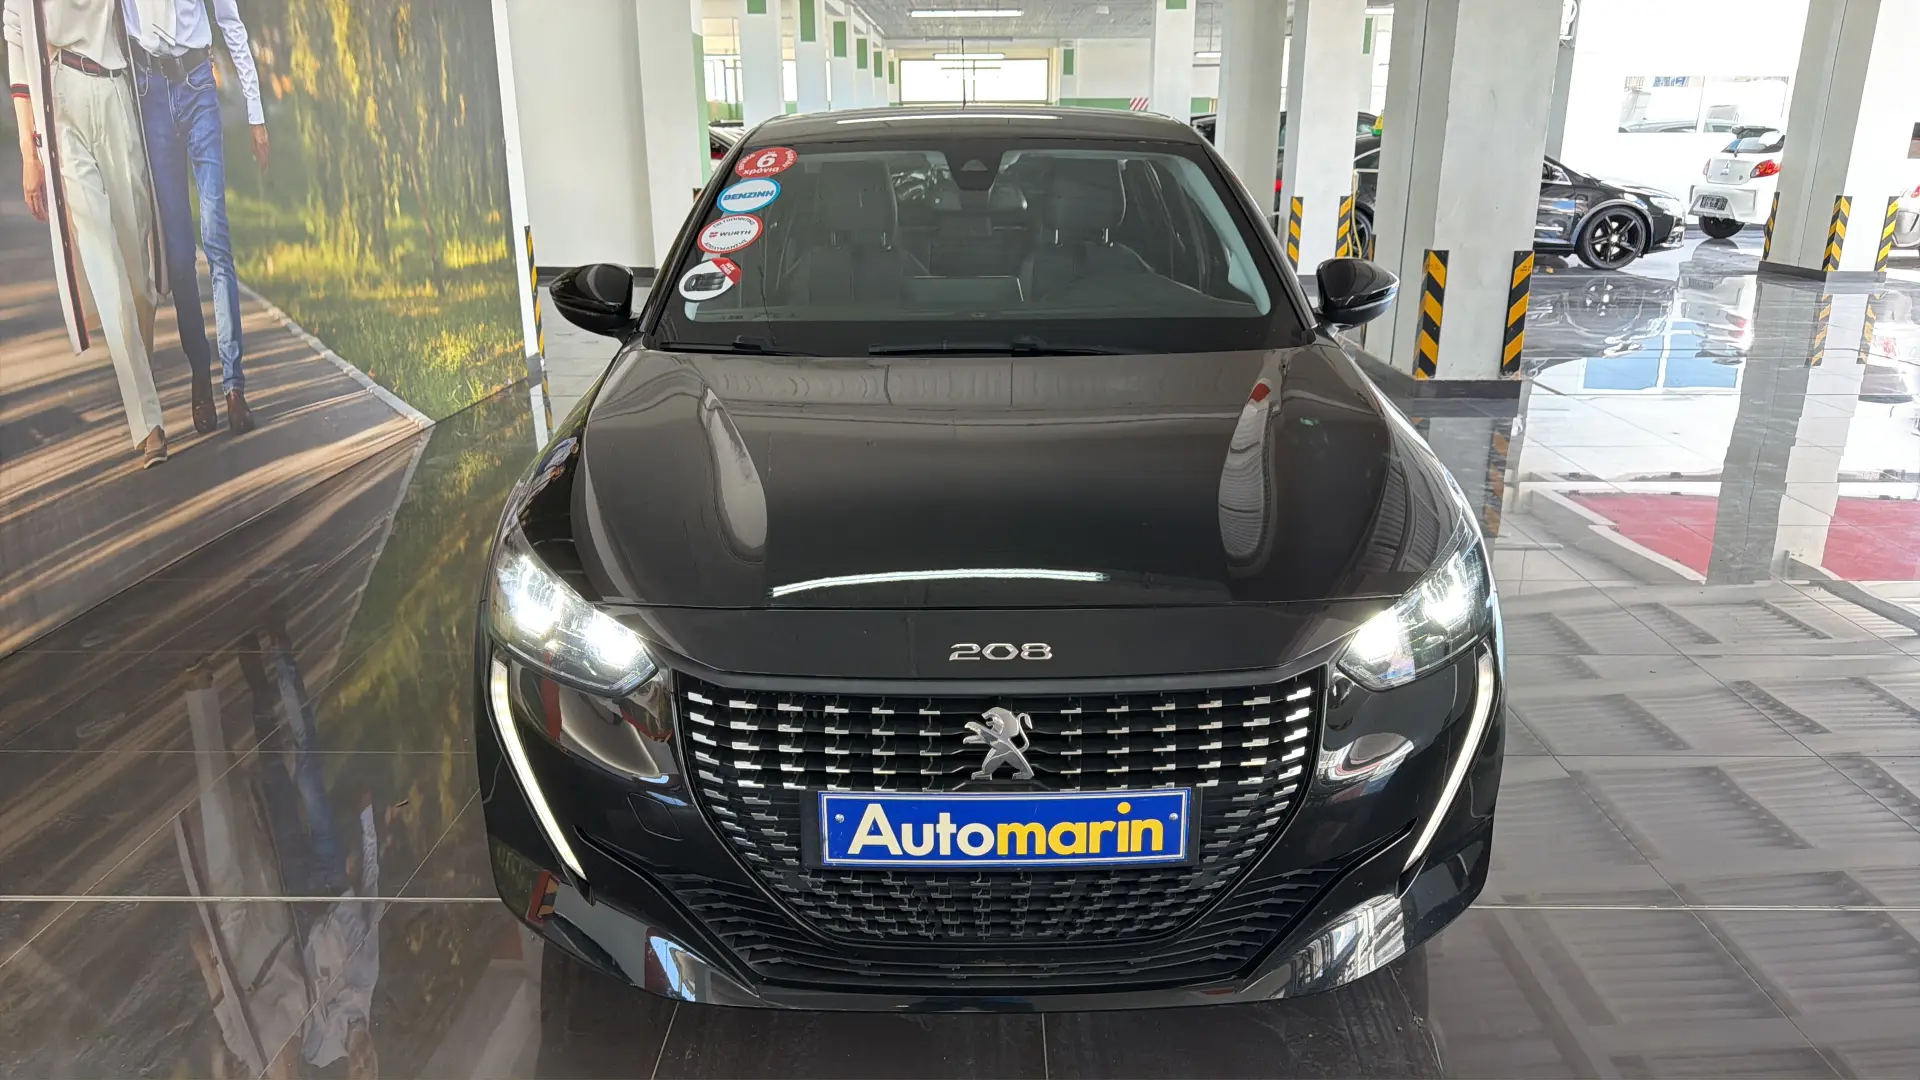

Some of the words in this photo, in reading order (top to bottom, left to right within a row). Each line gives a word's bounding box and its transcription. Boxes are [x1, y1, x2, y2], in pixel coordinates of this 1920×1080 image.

[757, 153, 778, 168] 6
[949, 642, 1053, 661] 208
[847, 801, 1164, 856] Automarin
